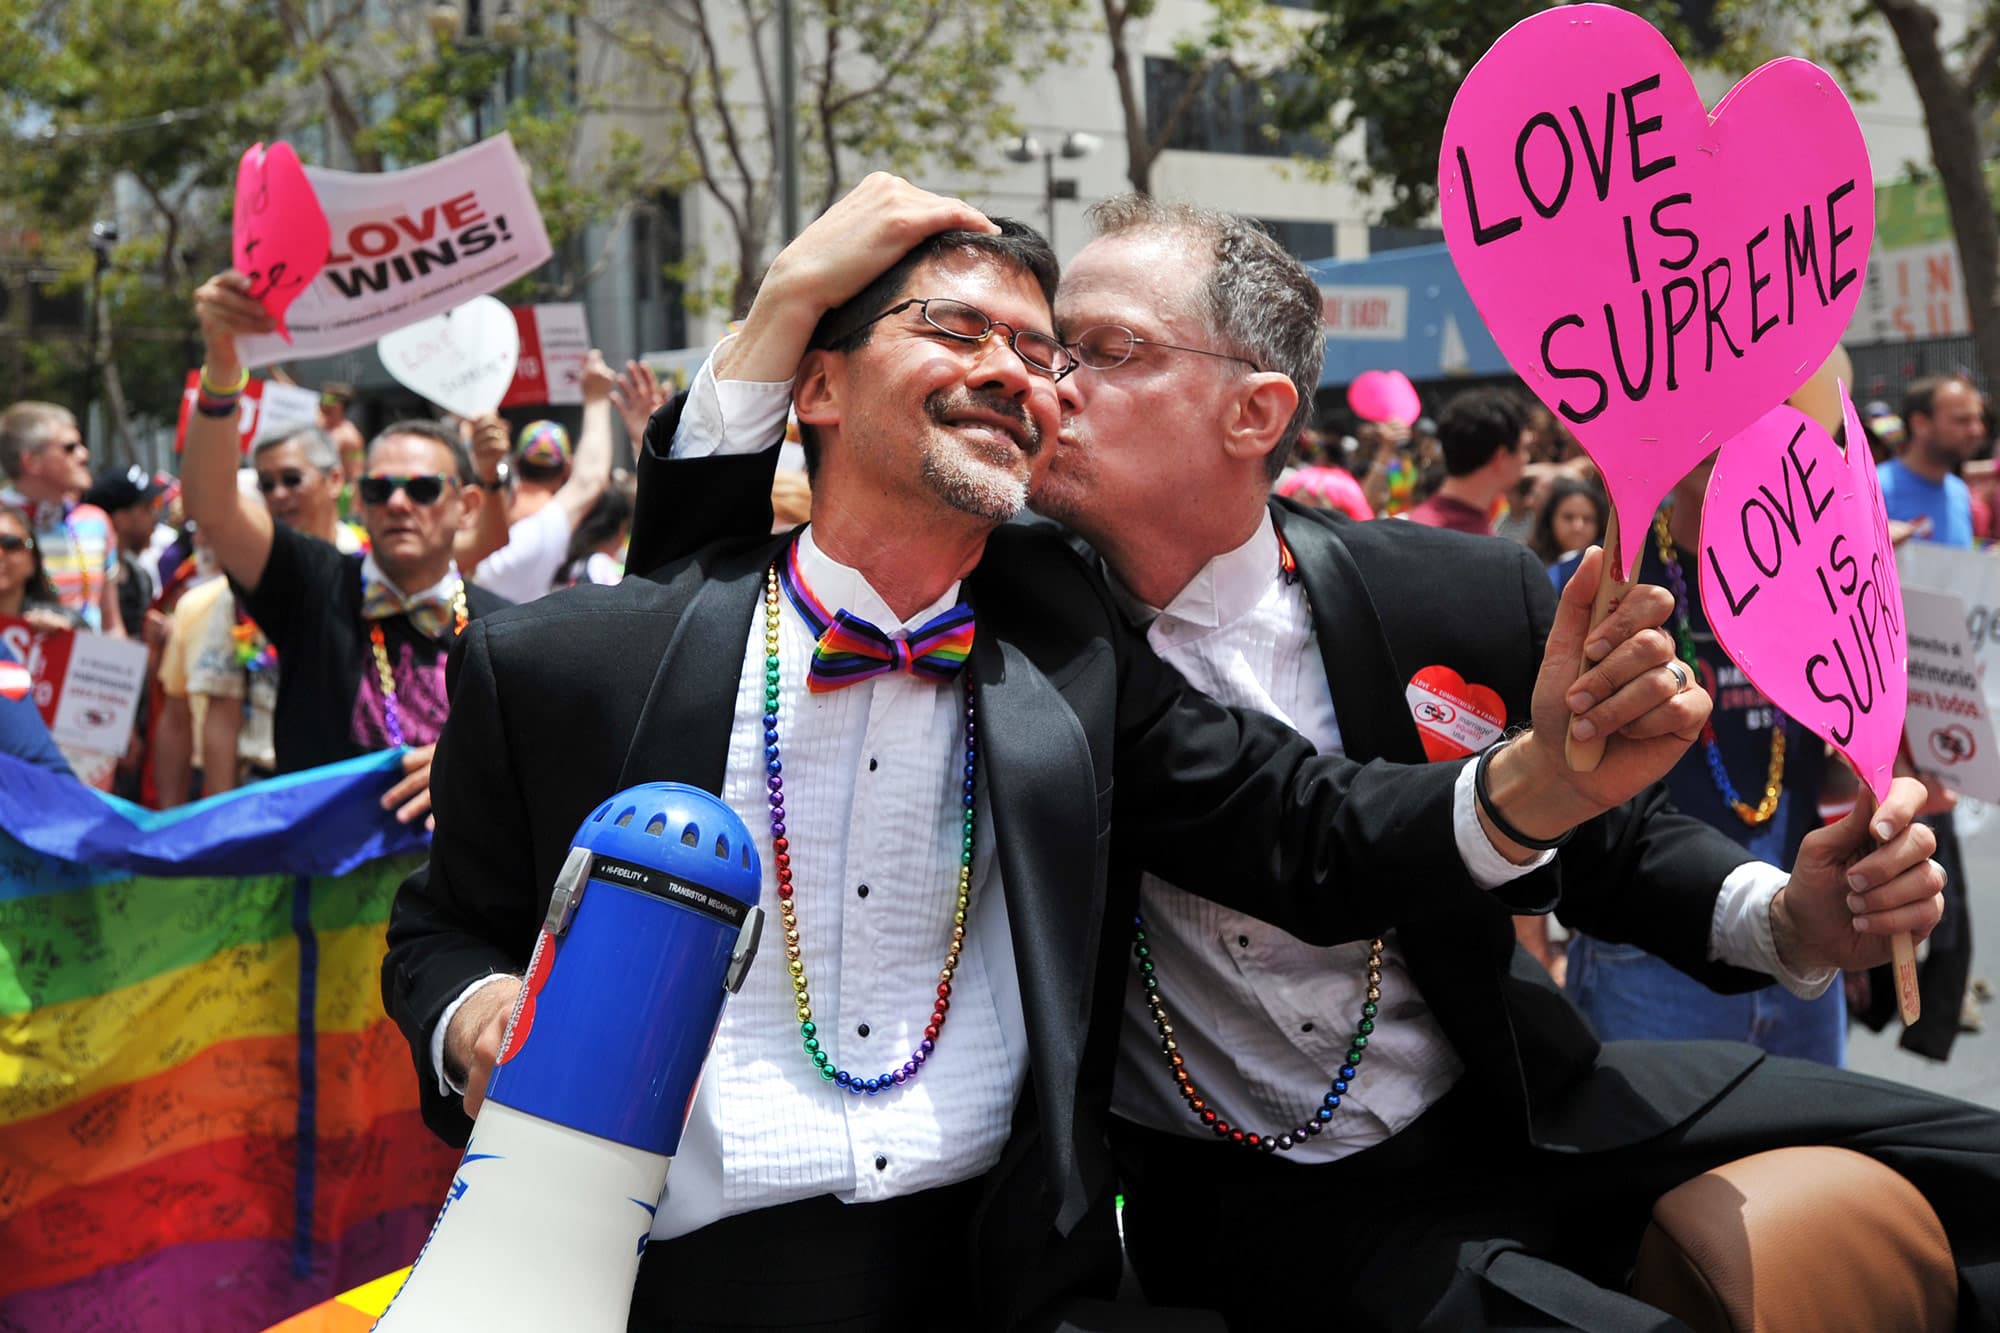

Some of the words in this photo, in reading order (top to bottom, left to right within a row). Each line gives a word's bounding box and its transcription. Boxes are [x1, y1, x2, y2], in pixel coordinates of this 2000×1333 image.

[1456, 74, 1676, 246] LOVE
[326, 214, 513, 299] WINS!
[1622, 193, 1699, 283] IS
[1540, 179, 1857, 424] SUPREME
[1706, 422, 1835, 617] LOVE
[1816, 534, 1858, 615] IS
[606, 864, 642, 882] HI-FIDELITY
[668, 882, 708, 904] TRANSISTOR
[707, 897, 738, 918] MEGAPHONE
